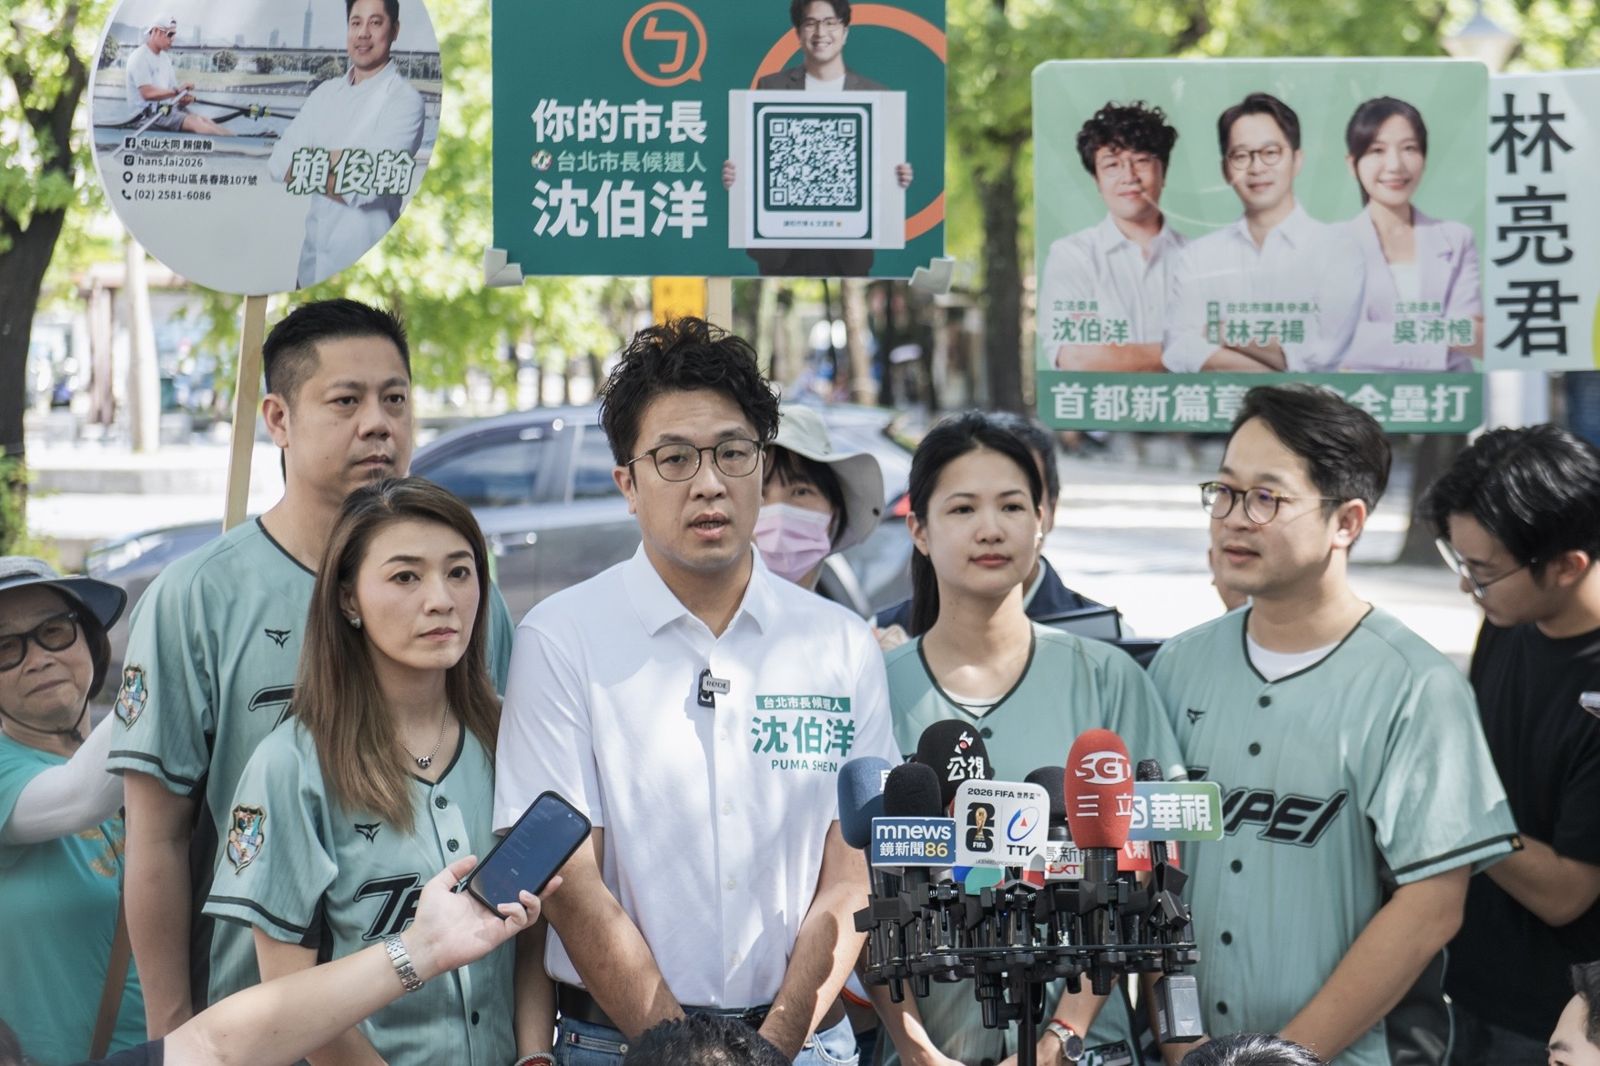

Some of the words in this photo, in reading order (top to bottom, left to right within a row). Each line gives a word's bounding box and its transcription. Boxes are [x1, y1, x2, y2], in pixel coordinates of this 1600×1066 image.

[531, 99, 708, 144] 你的市長
[140, 138, 180, 150] 中山大同
[137, 156, 204, 168] hans.lai2026
[288, 148, 416, 196] 賴俊翰
[556, 150, 707, 173] 台北市長候選人
[136, 173, 258, 186] 台北市中山區長春路107號
[134, 189, 155, 201] (02)
[158, 190, 212, 201] 2581-6086
[531, 179, 708, 239] 沈伯洋
[1489, 92, 1579, 358] 林亮君
[1052, 317, 1130, 343] 沈伯洋
[1226, 319, 1305, 345] 林子揚
[1393, 319, 1473, 344] 吳沛憶
[1321, 384, 1471, 423] 全壘打
[763, 696, 843, 711] 台北市長候選人
[750, 715, 856, 757] 沈伯洋
[771, 759, 809, 771] PUMA
[812, 760, 838, 773] SHEN
[946, 755, 985, 782] 公視
[967, 787, 993, 798] 2026
[994, 789, 1015, 799] FIFA
[1076, 793, 1132, 817] 三立
[1150, 793, 1213, 832] 華視
[876, 825, 952, 841] mnews
[879, 842, 948, 858] 鏡新聞86
[972, 841, 987, 849] FIFA
[1006, 844, 1037, 857] TTV
